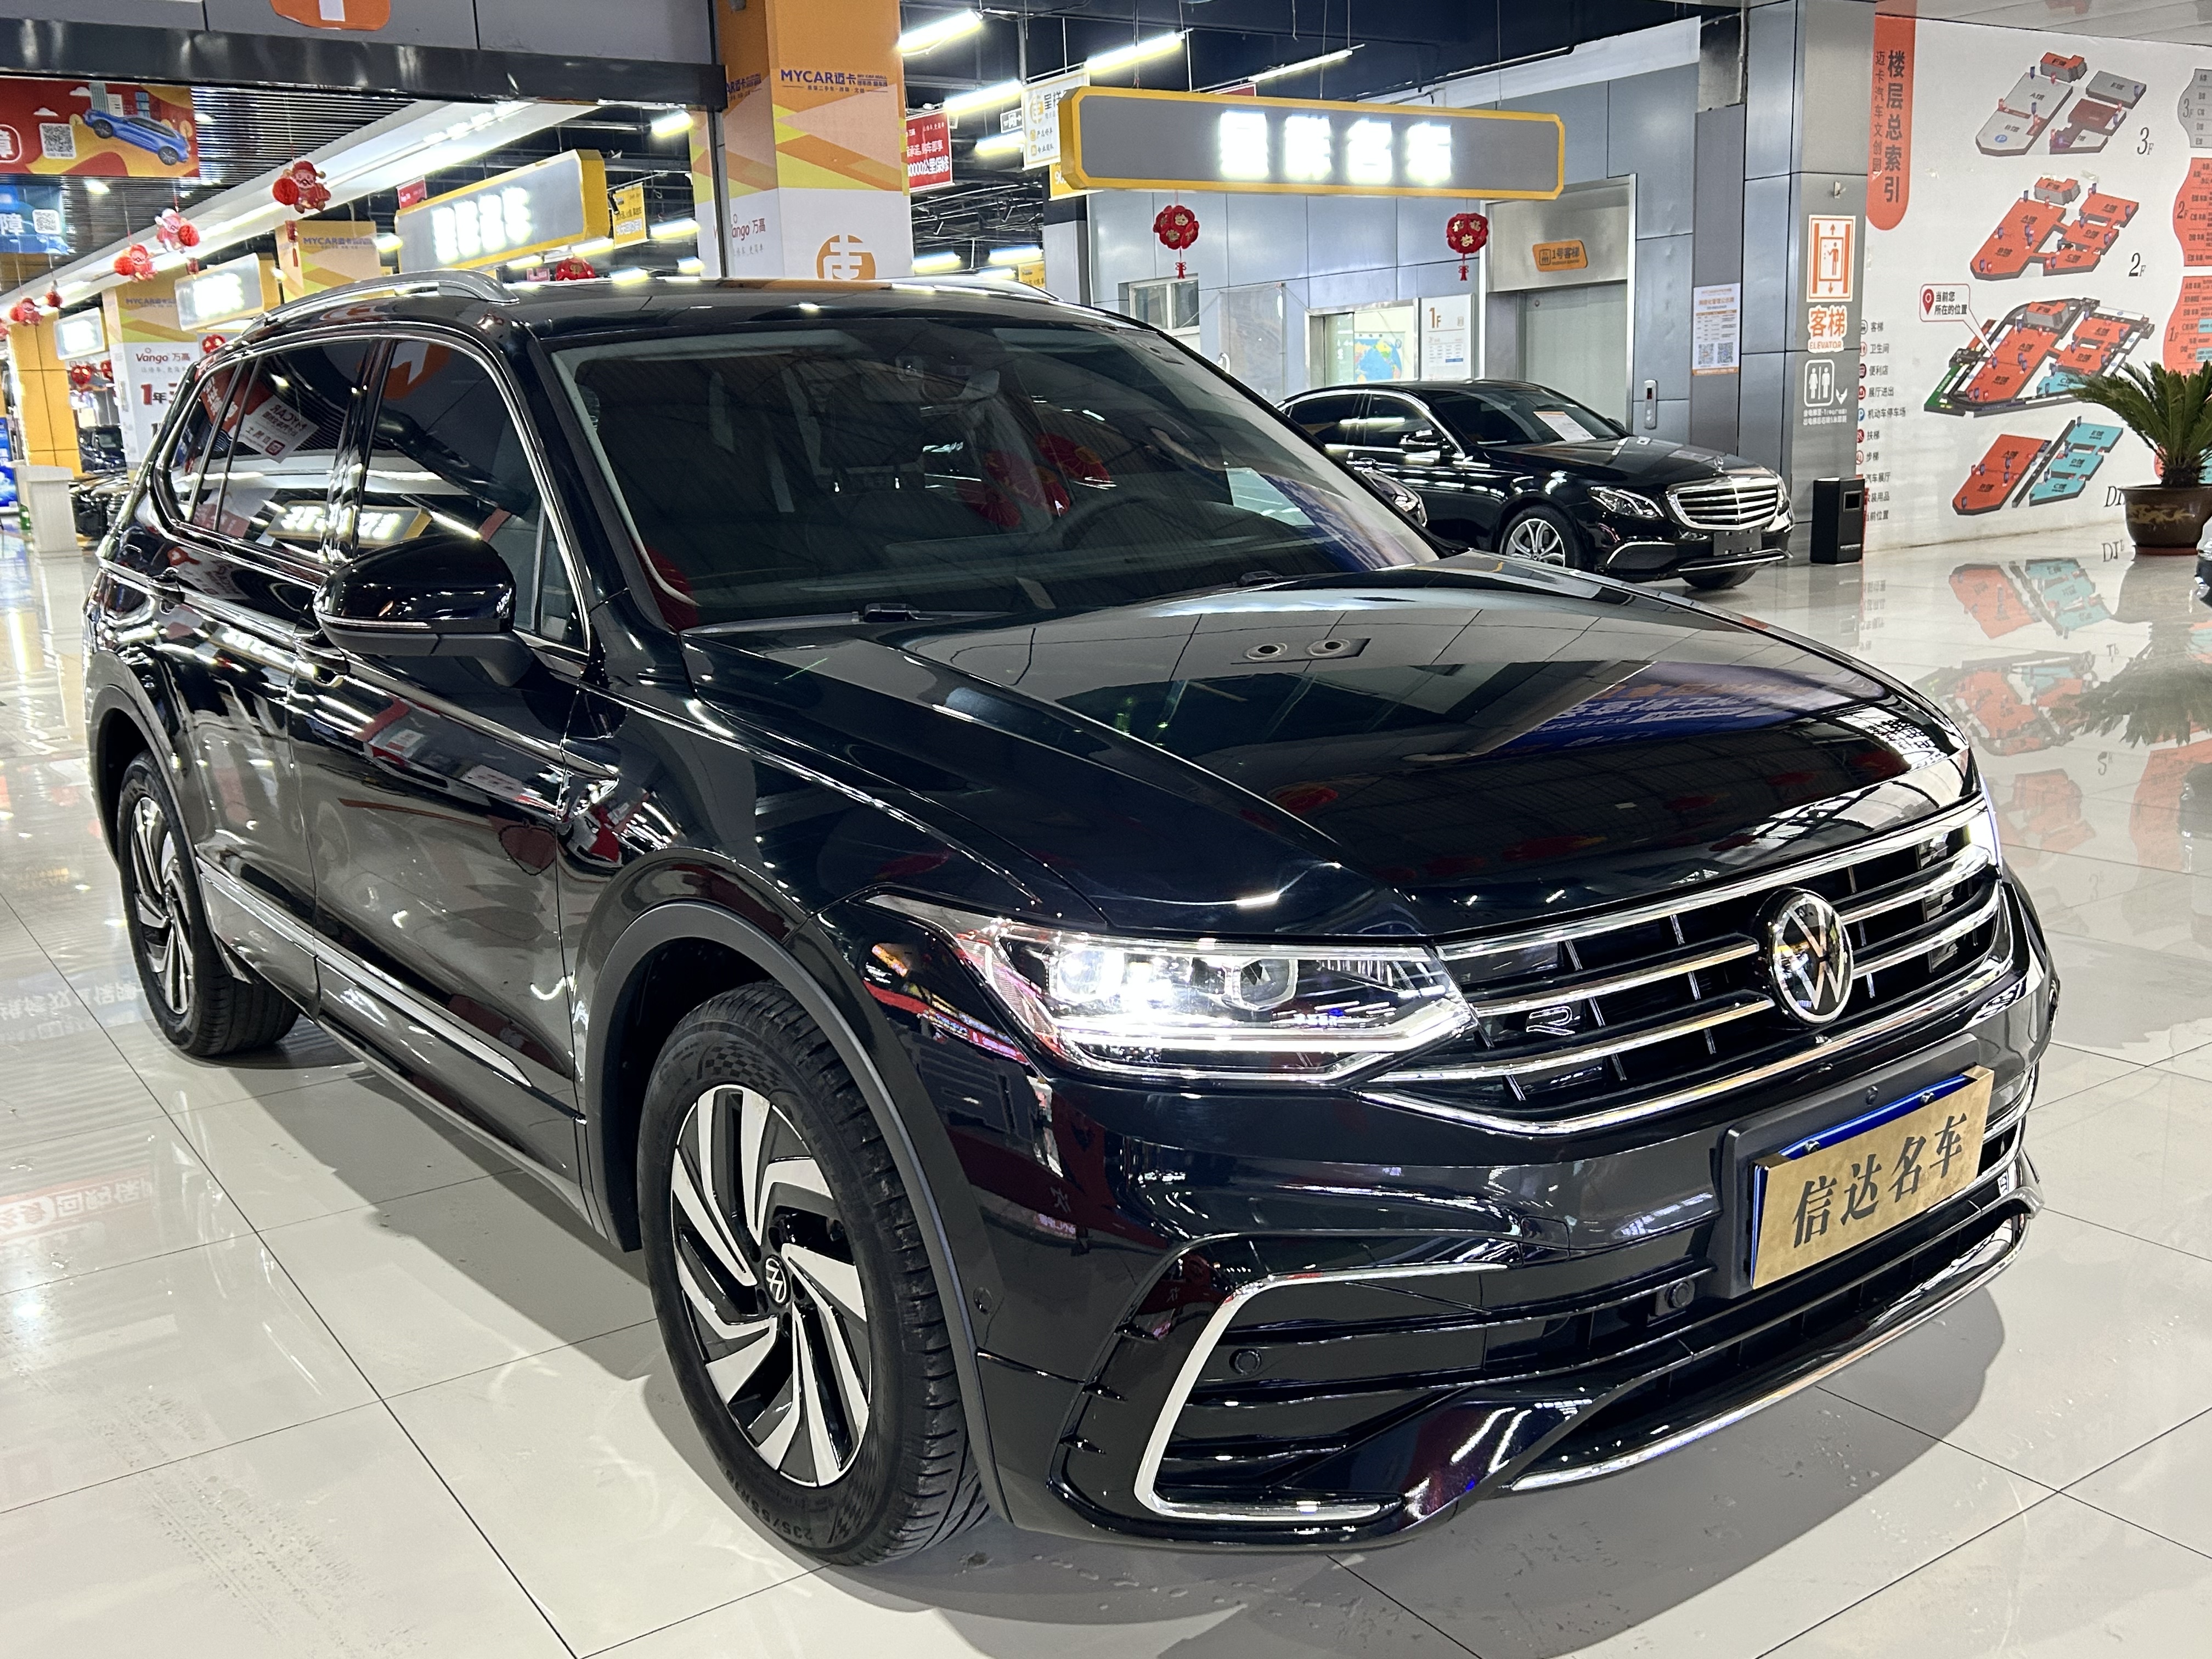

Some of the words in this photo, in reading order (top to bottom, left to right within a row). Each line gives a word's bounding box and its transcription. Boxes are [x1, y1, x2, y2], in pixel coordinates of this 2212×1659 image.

[1884, 50, 1905, 202] 楼层总索引
[2137, 127, 2154, 155] 3F
[2129, 252, 2147, 278] 2F
[1936, 291, 1956, 302] 当前您
[1934, 304, 1968, 315] 所在的位置
[1429, 307, 1442, 329] 1F
[1810, 308, 1846, 337] 客梯
[1871, 321, 1884, 332] 客梯
[1809, 341, 1842, 349] ELEVATOR
[1870, 343, 1889, 354] 卫生间
[136, 353, 169, 364] Vango
[1869, 365, 1888, 376] 便利店
[1868, 407, 1906, 419] 机动车停车场
[1866, 472, 1891, 483] 汽车展厅
[1793, 1112, 1967, 1249] 信达名车
